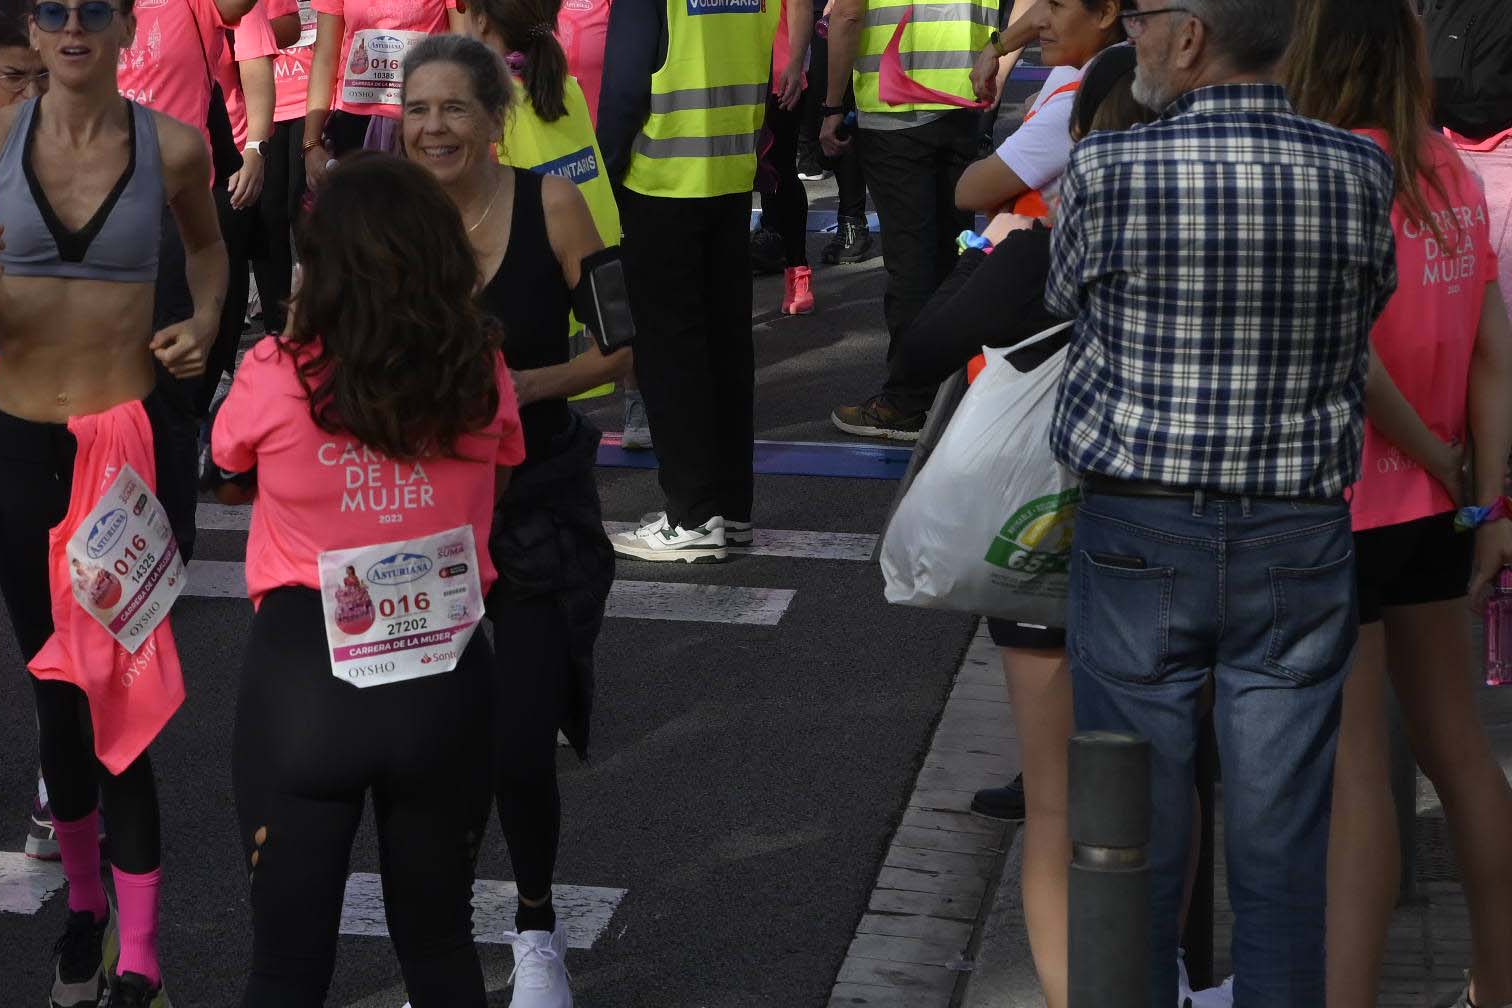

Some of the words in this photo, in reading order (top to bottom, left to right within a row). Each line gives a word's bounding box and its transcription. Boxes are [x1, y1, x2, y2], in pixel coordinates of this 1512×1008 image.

[371, 58, 399, 70] 016
[345, 463, 382, 489] DE
[394, 462, 430, 485] LA
[340, 484, 436, 513] MUJER
[89, 513, 127, 558] ASTURIANA
[113, 533, 148, 577] 016
[131, 551, 157, 586] 14325
[372, 562, 429, 582] ASTURIANA
[378, 591, 431, 618] 016
[129, 600, 162, 638] OYSHO
[387, 617, 428, 636] 27202
[349, 642, 392, 657] CARRERA
[393, 639, 406, 649] DE
[406, 637, 419, 647] LA
[420, 631, 452, 644] MUJER
[348, 661, 396, 679] OYSHO
